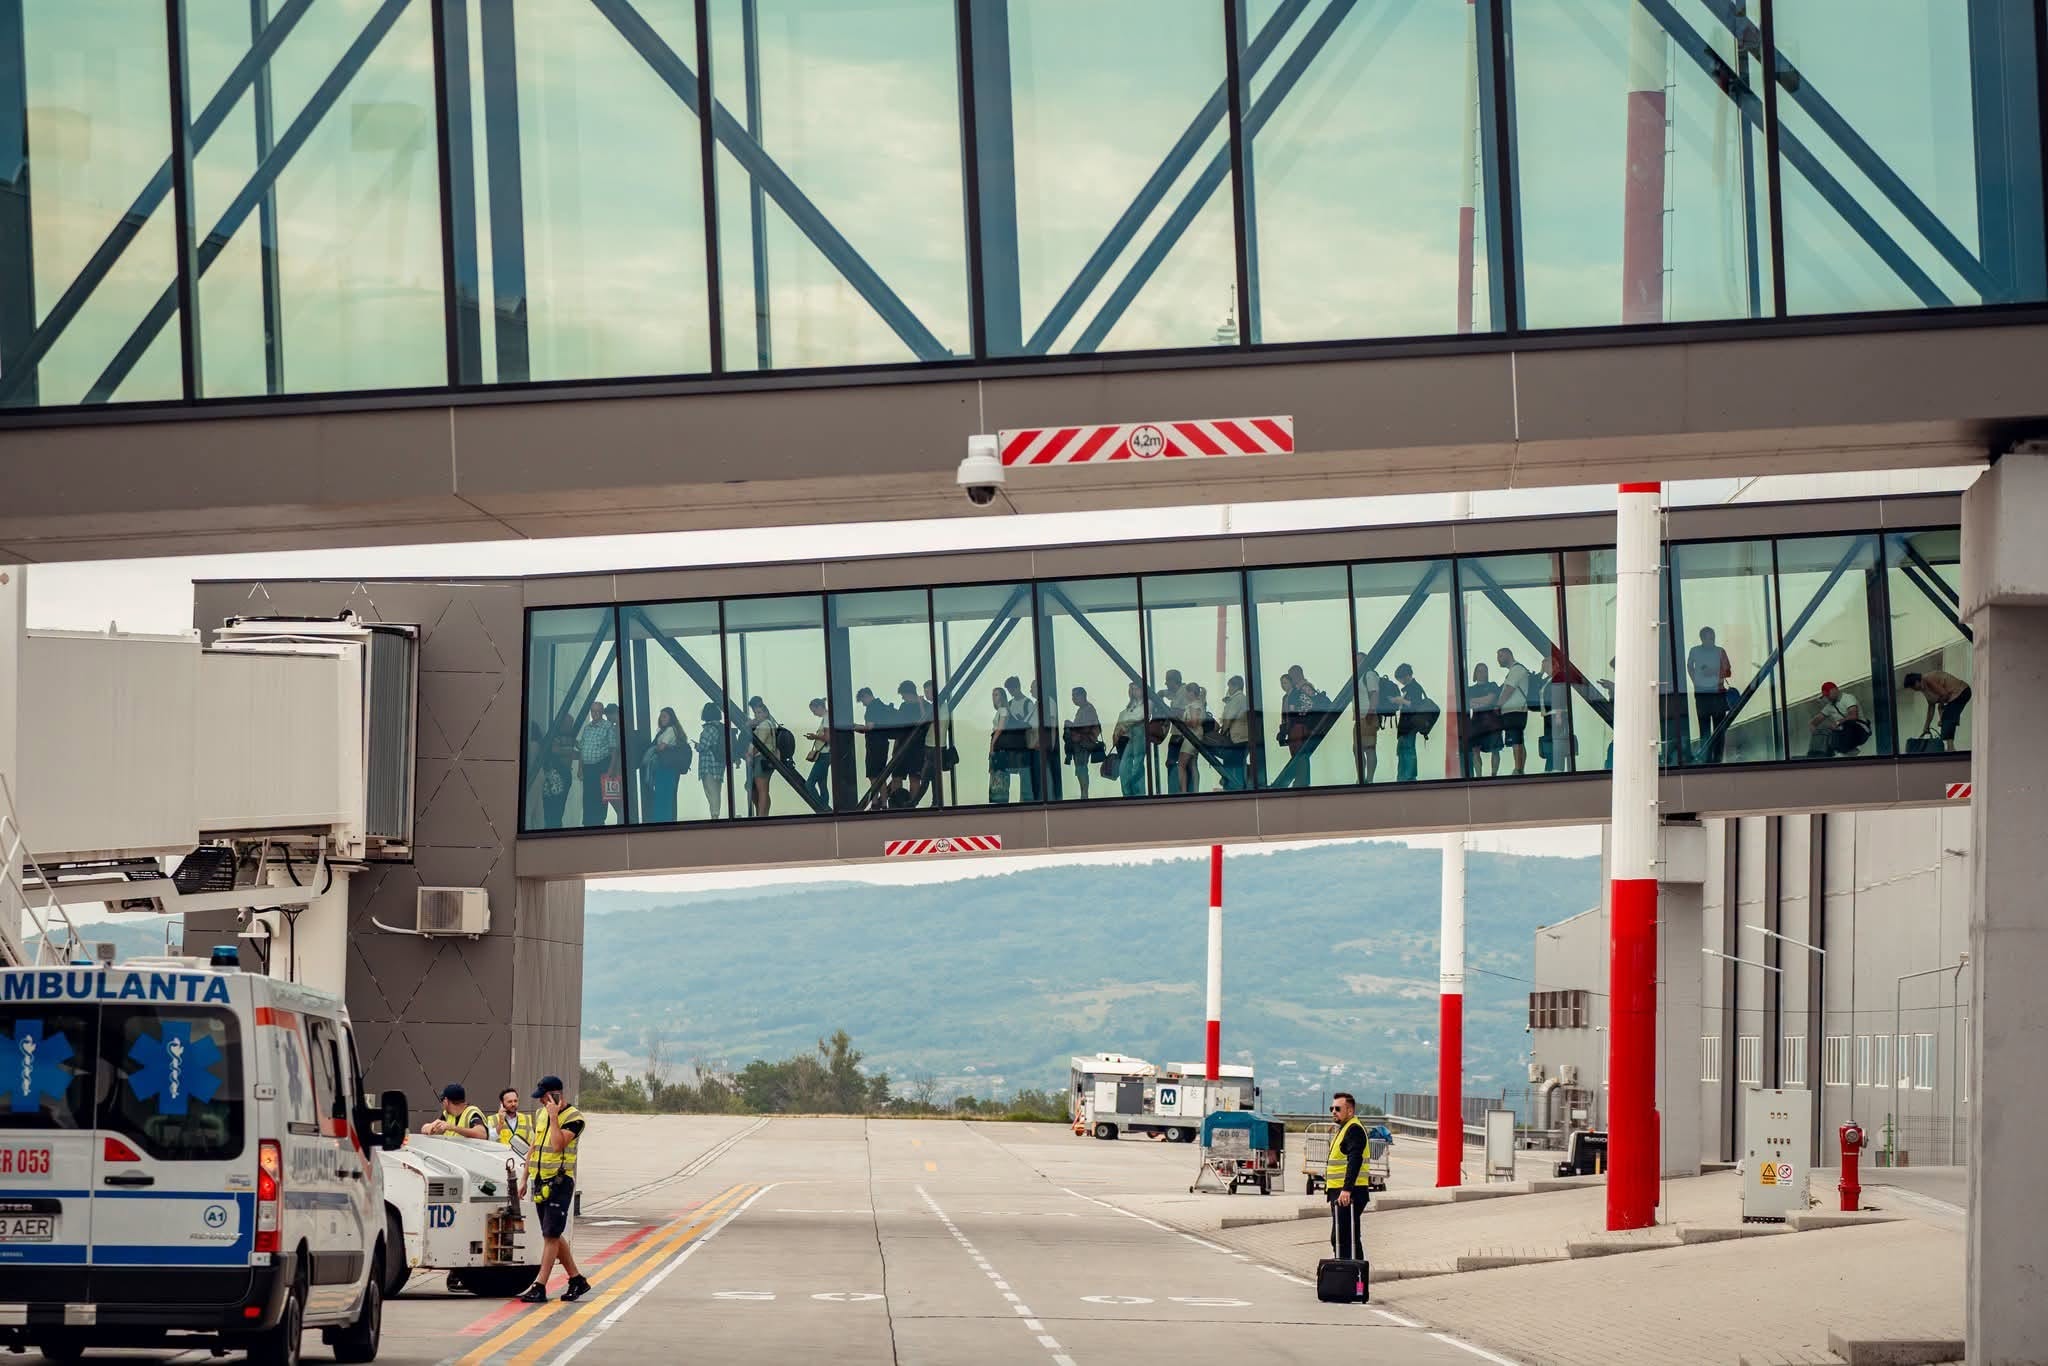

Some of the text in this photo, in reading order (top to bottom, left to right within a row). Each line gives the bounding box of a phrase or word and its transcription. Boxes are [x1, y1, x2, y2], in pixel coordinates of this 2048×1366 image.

[1133, 434, 1160, 448] 4,2m
[0, 972, 231, 1003] MBULANTA
[18, 1149, 50, 1174] 053
[208, 1212, 224, 1222] A1
[428, 1205, 456, 1228] TLD
[12, 1220, 48, 1235] AER
